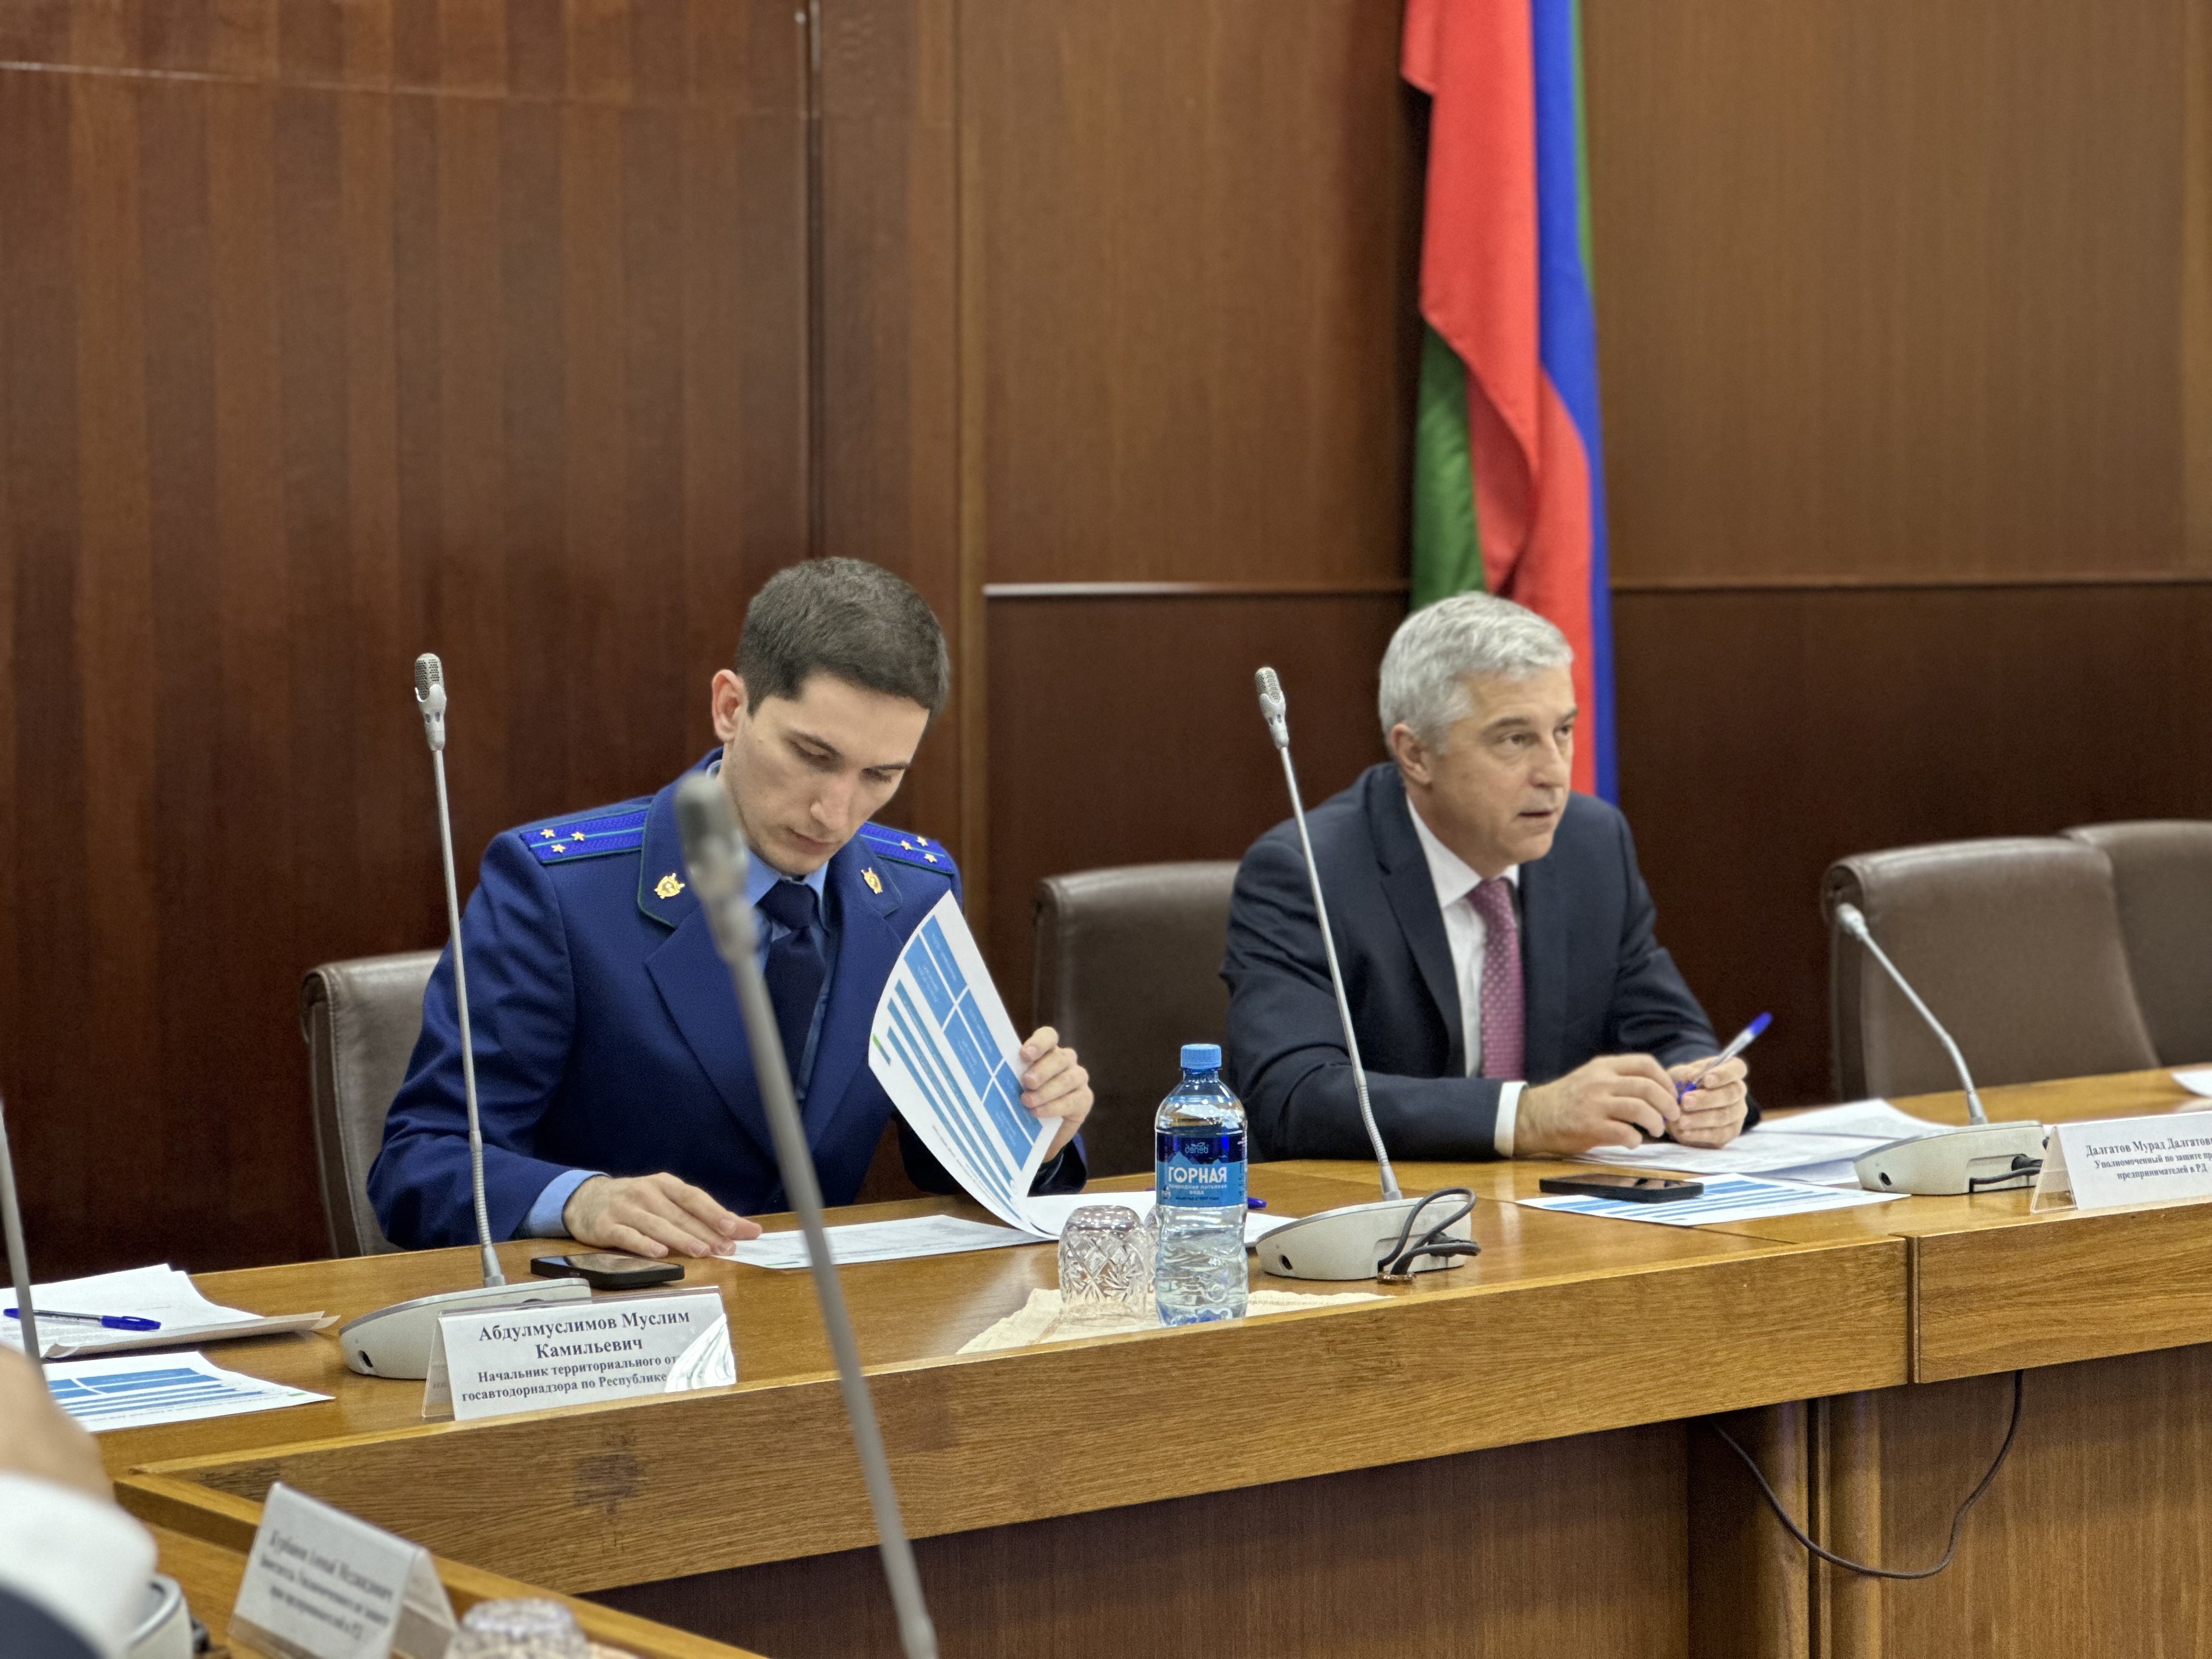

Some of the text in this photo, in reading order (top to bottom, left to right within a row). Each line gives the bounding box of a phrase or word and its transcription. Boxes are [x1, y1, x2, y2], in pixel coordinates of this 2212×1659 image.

[2086, 1137, 2212, 1157] Далгатов Мурад Далгатов
[2094, 1154, 2163, 1169] Уполномоченный
[2175, 1153, 2202, 1161] защите
[1168, 1167, 1227, 1183] ГОРНАЯ
[2117, 1165, 2188, 1181] предпринимателей
[2196, 1163, 2208, 1173] РД
[479, 1312, 690, 1342] Абдулмуслимов Муслим
[536, 1338, 643, 1359] Камильевич
[478, 1368, 549, 1383] Начальник
[552, 1357, 662, 1375] территориального
[462, 1383, 578, 1402] госавтодорнадзора
[581, 1381, 596, 1390] по
[599, 1374, 667, 1390] Республике
